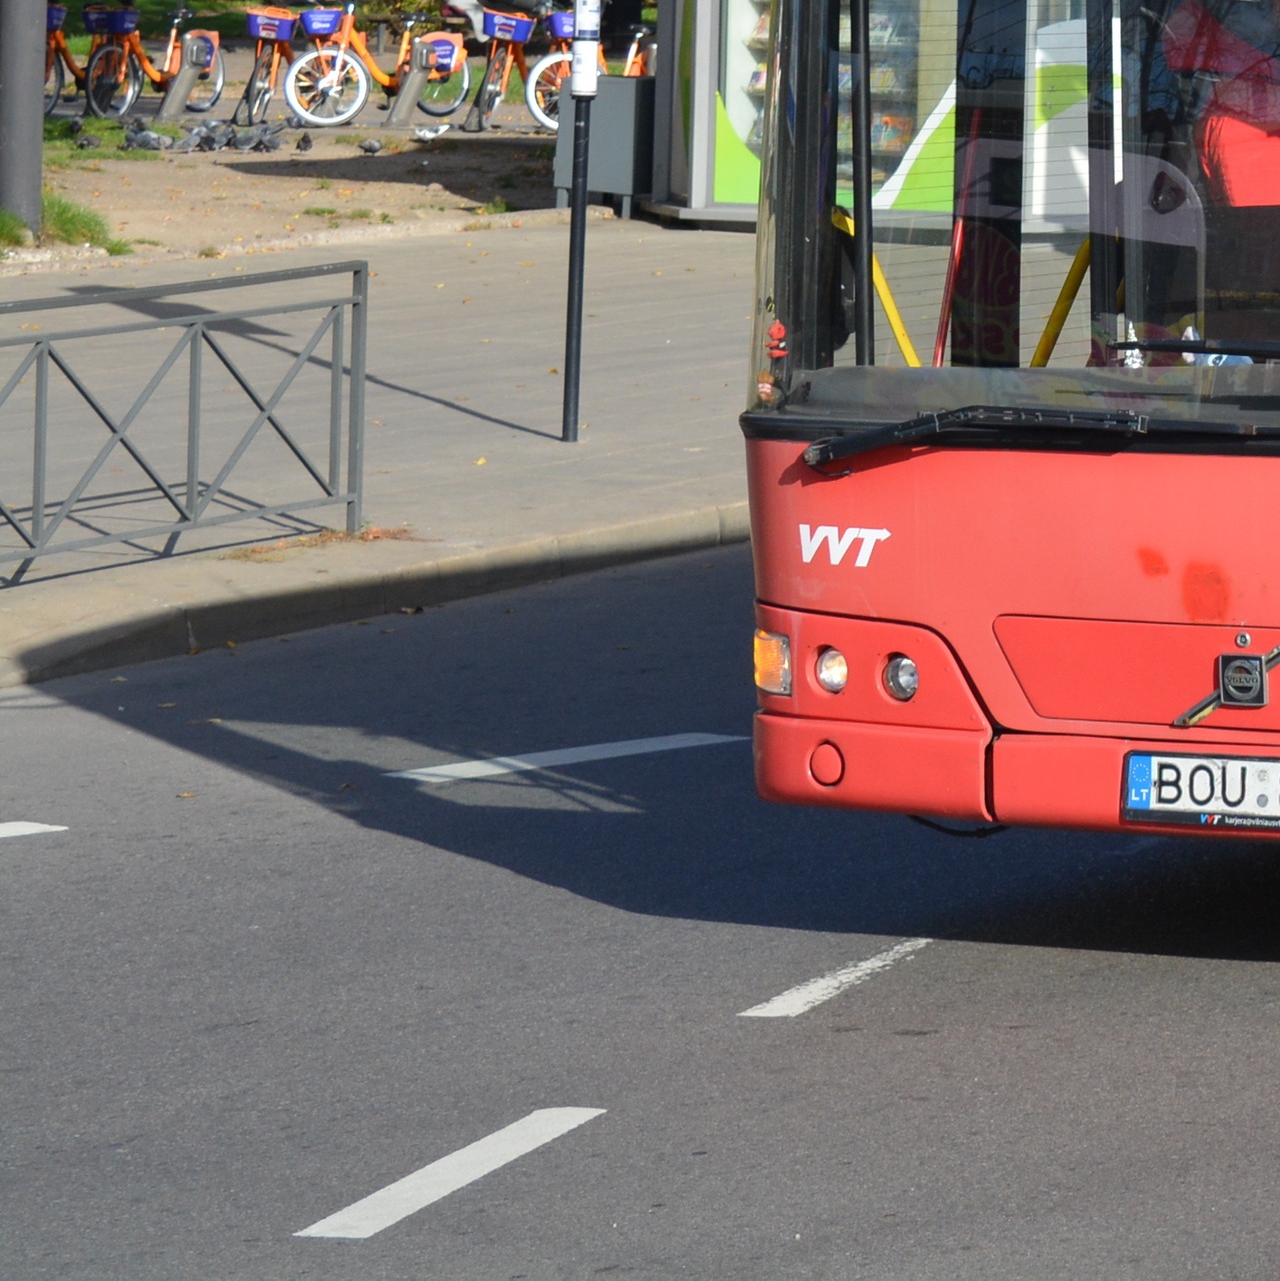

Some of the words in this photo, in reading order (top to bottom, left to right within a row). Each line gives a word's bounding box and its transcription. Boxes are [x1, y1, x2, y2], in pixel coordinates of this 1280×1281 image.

[799, 523, 892, 567] VVT
[1226, 676, 1259, 684] VOLVO
[1131, 788, 1149, 802] LT
[1156, 762, 1247, 807] BOU
[1200, 813, 1222, 825] VVT
